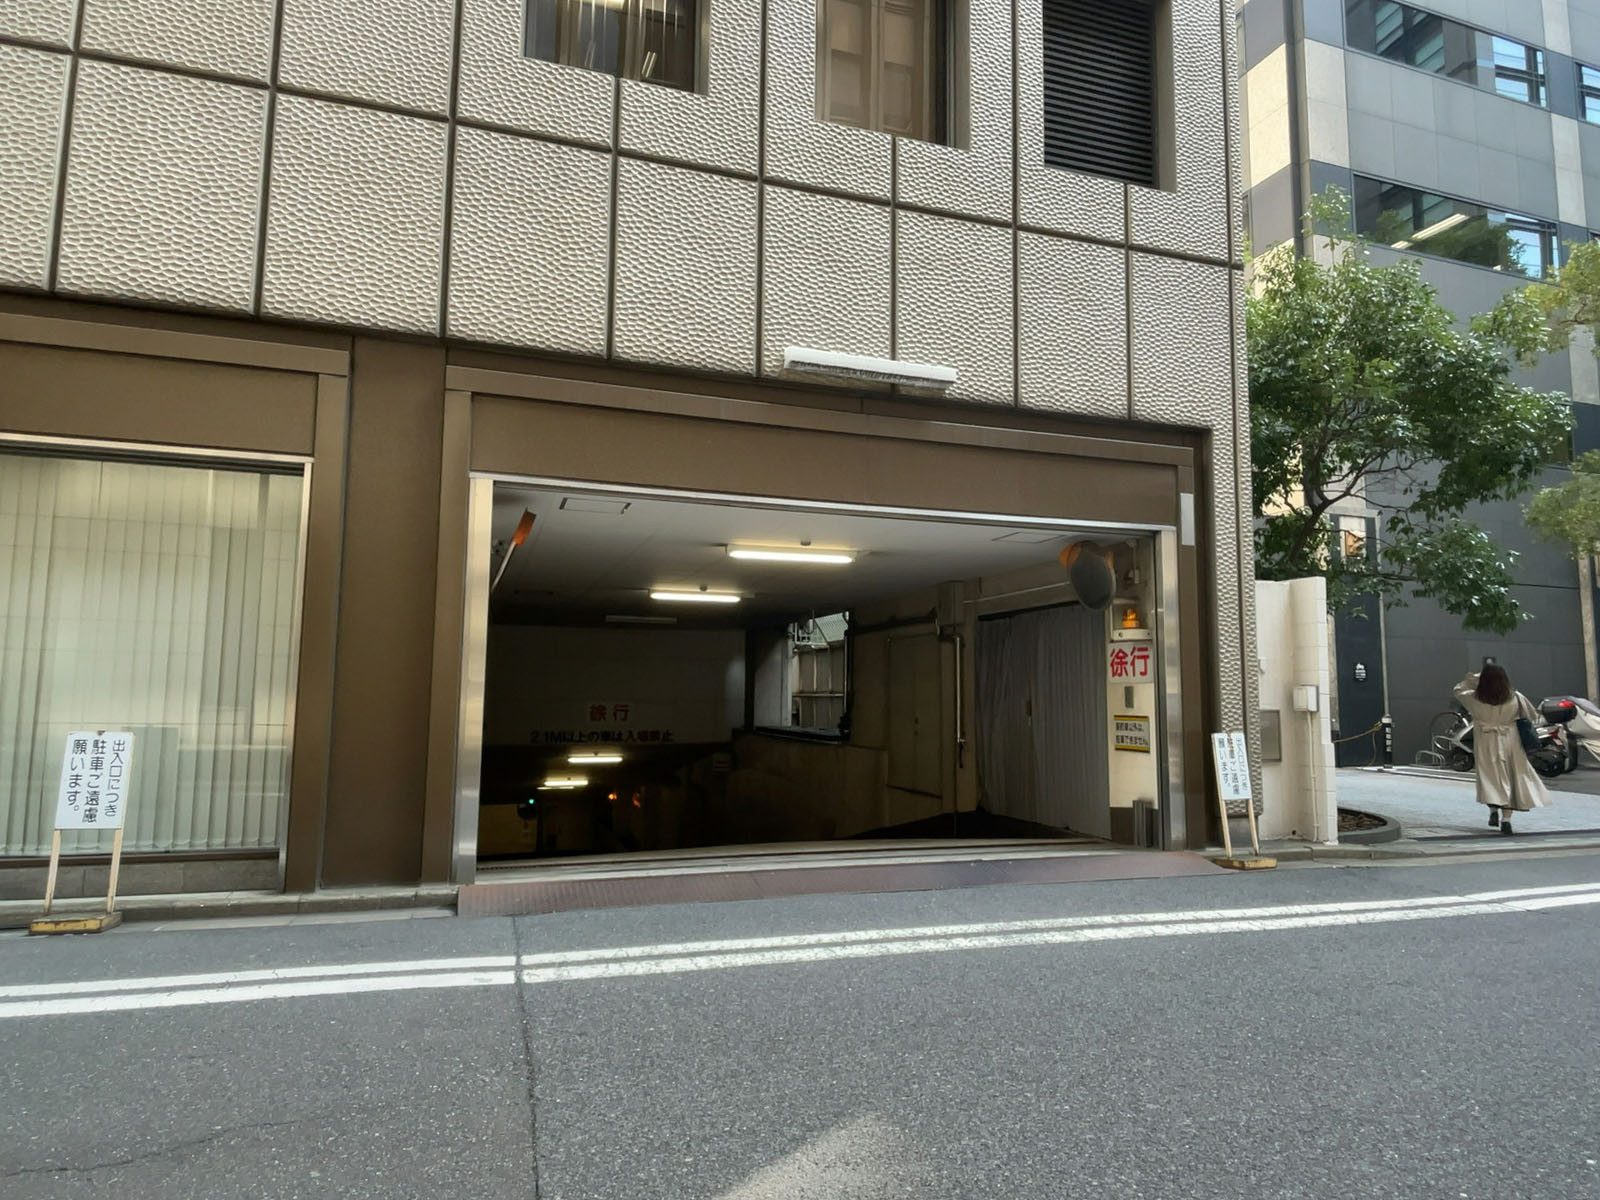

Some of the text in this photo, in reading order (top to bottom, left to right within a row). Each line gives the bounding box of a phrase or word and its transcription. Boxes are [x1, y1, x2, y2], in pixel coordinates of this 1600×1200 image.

[1109, 646, 1150, 678] 徐行
[589, 703, 630, 721] 徐行
[66, 739, 88, 813] 願います。
[82, 739, 107, 823] 駐車ご遠慮
[104, 739, 125, 818] 出入口につき
